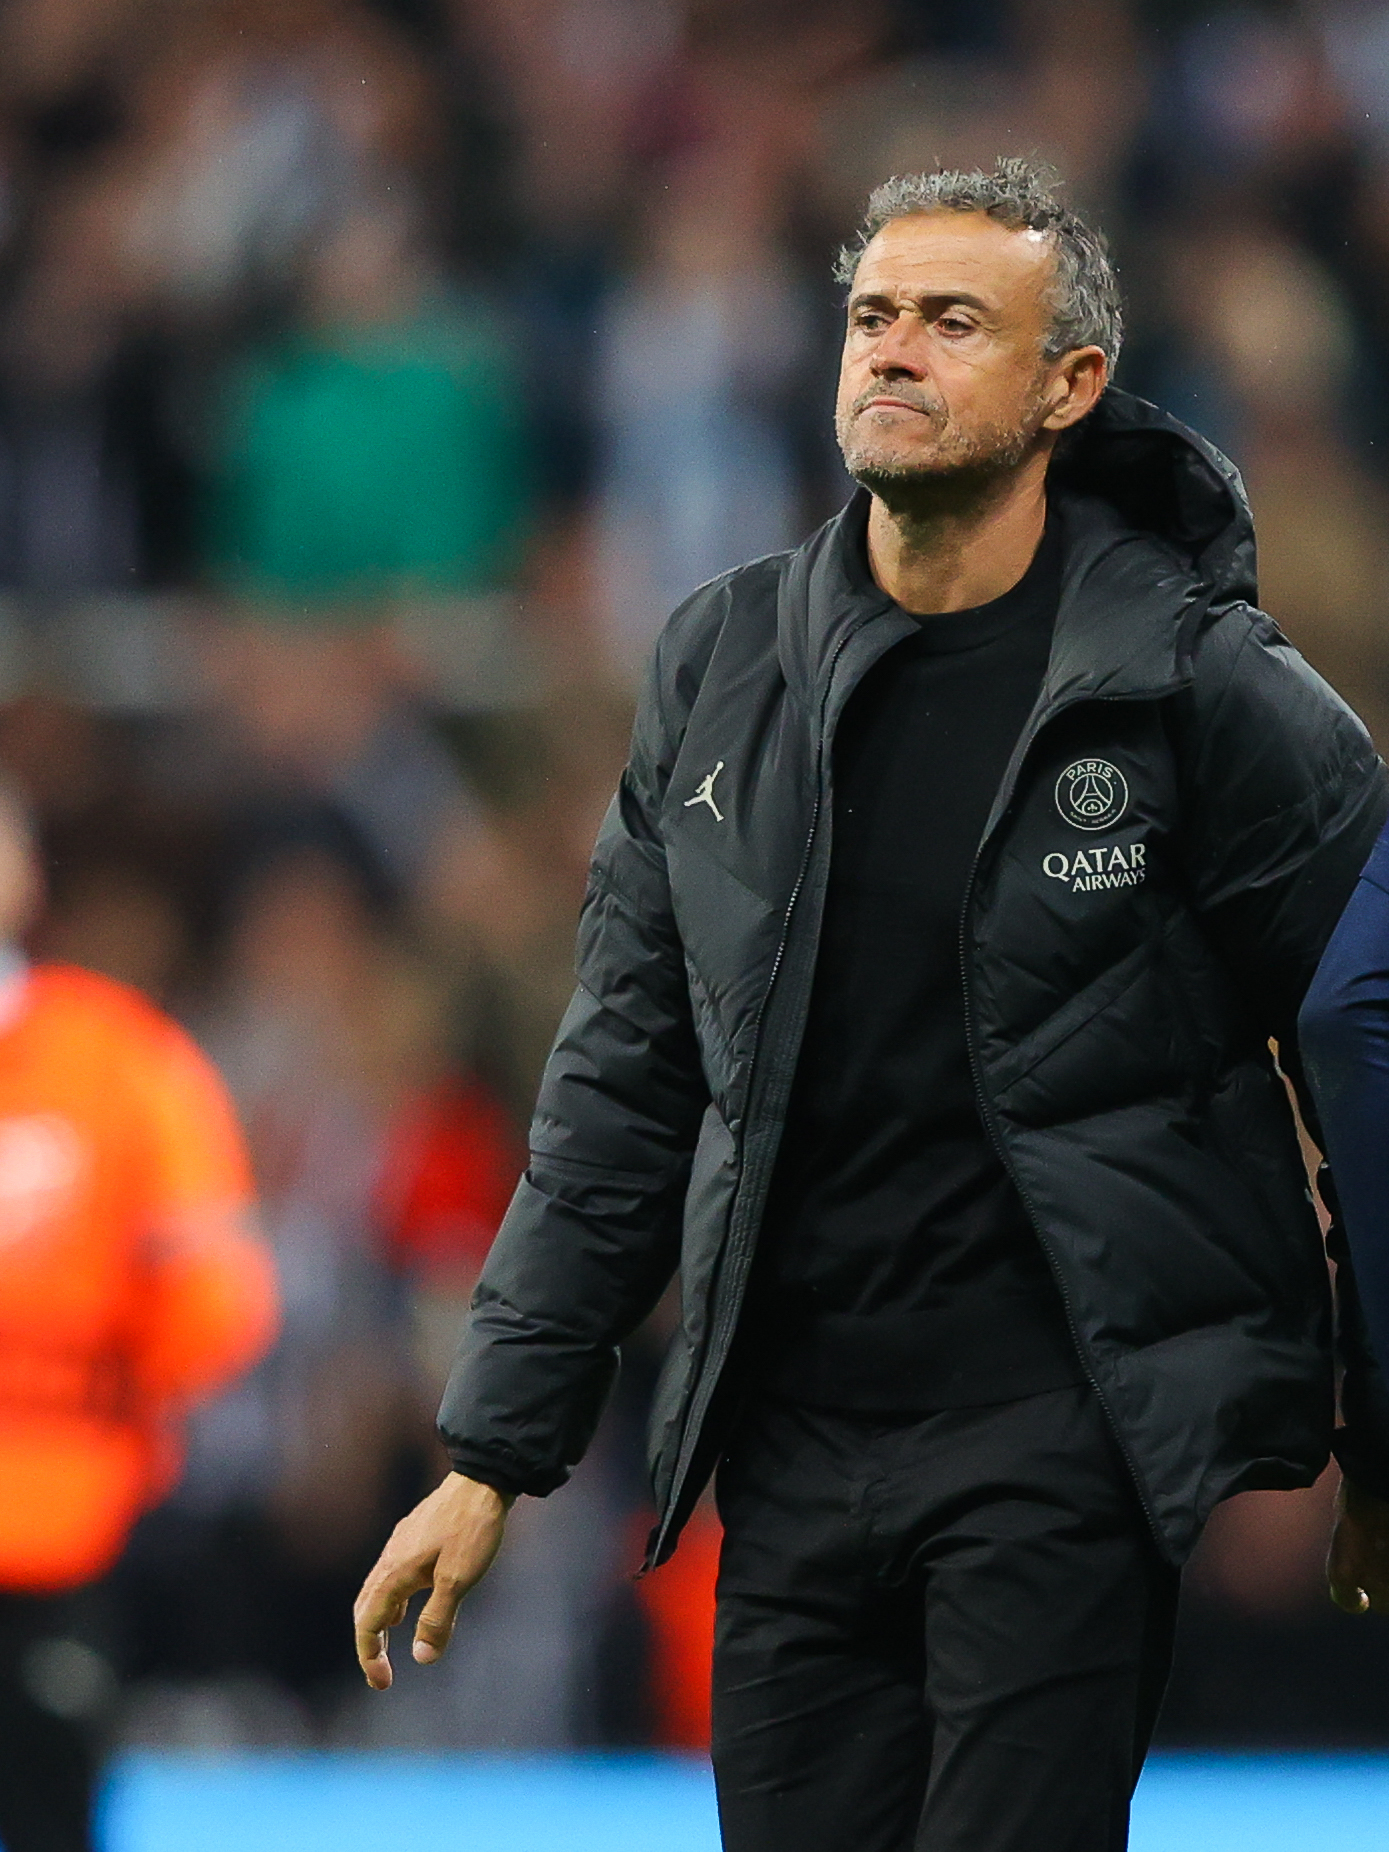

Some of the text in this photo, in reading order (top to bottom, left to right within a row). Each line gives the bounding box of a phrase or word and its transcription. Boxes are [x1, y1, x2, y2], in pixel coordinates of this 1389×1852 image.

[1066, 762, 1113, 780] PARIS
[1042, 843, 1146, 882] QATAR
[1072, 868, 1146, 892] AIRWAYS
